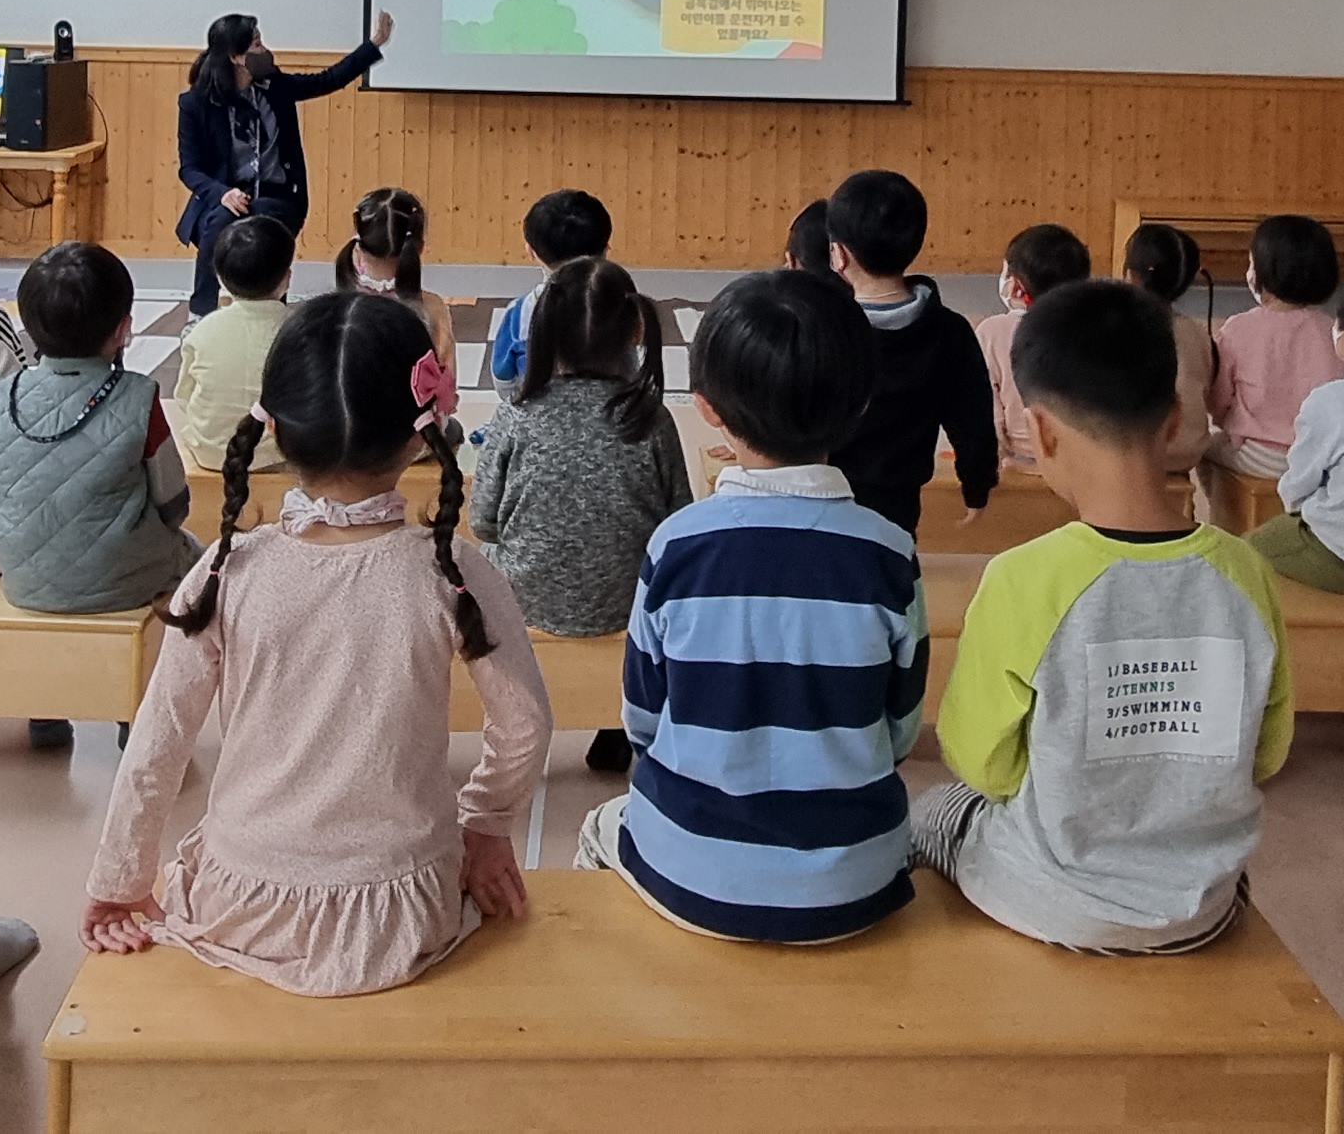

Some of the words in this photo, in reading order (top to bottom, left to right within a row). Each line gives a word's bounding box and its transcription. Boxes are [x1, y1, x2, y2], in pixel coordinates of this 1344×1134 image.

[729, 13, 775, 27] 운전자가
[793, 15, 806, 27] 수
[1107, 660, 1199, 678] 1/BASEBALL
[1106, 681, 1176, 699] 2/TENNIS
[1106, 701, 1203, 719] 3/SWIMMING
[1105, 721, 1200, 739] 4/FOOTBALL
